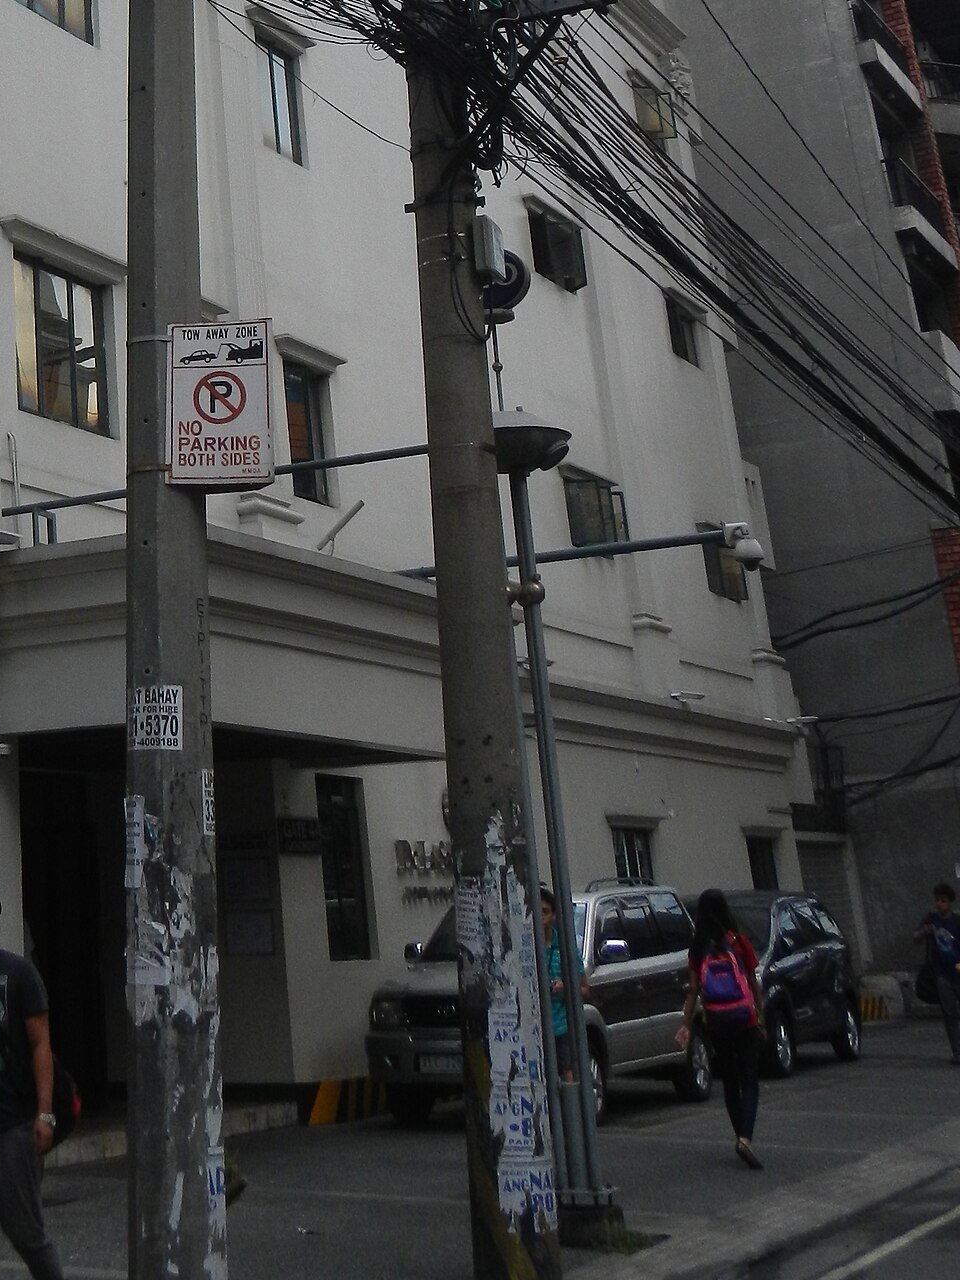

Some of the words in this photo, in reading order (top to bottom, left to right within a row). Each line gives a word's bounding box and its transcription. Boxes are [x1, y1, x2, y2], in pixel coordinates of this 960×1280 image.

[182, 329, 200, 341] TOW
[205, 327, 229, 340] AWAY
[236, 325, 258, 339] ZONE
[178, 420, 203, 436] NO
[178, 435, 261, 452] PARKING
[178, 452, 215, 467] BOTH
[221, 451, 261, 467] SIDES
[144, 688, 178, 704] BAHAY
[142, 705, 157, 713] FOR
[158, 705, 178, 713] HIRE
